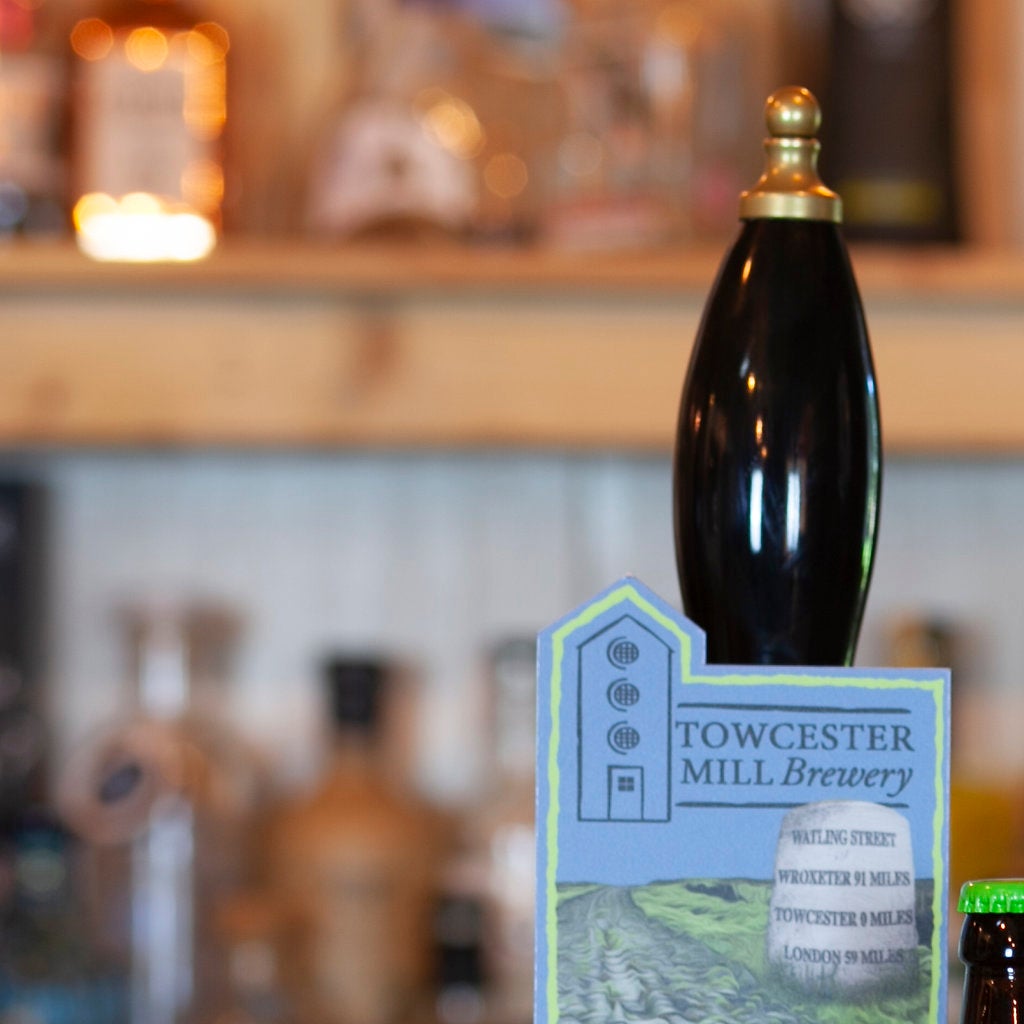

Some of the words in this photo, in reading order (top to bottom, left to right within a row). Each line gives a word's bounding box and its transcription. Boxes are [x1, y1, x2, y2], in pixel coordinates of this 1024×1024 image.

[675, 721, 915, 752] TOWCESTER
[680, 759, 774, 786] MILL
[780, 757, 913, 797] Brewery
[792, 829, 848, 845] WATLING
[850, 831, 897, 847] STREET
[778, 869, 853, 886] WROXETER
[854, 871, 866, 886] 91
[869, 871, 911, 887] MILES
[774, 907, 857, 927] TOWCESTER
[860, 911, 867, 927] 0
[870, 909, 913, 927] MILES
[784, 945, 841, 965] LONDON
[844, 949, 859, 965] 59
[861, 948, 904, 965] MILES
